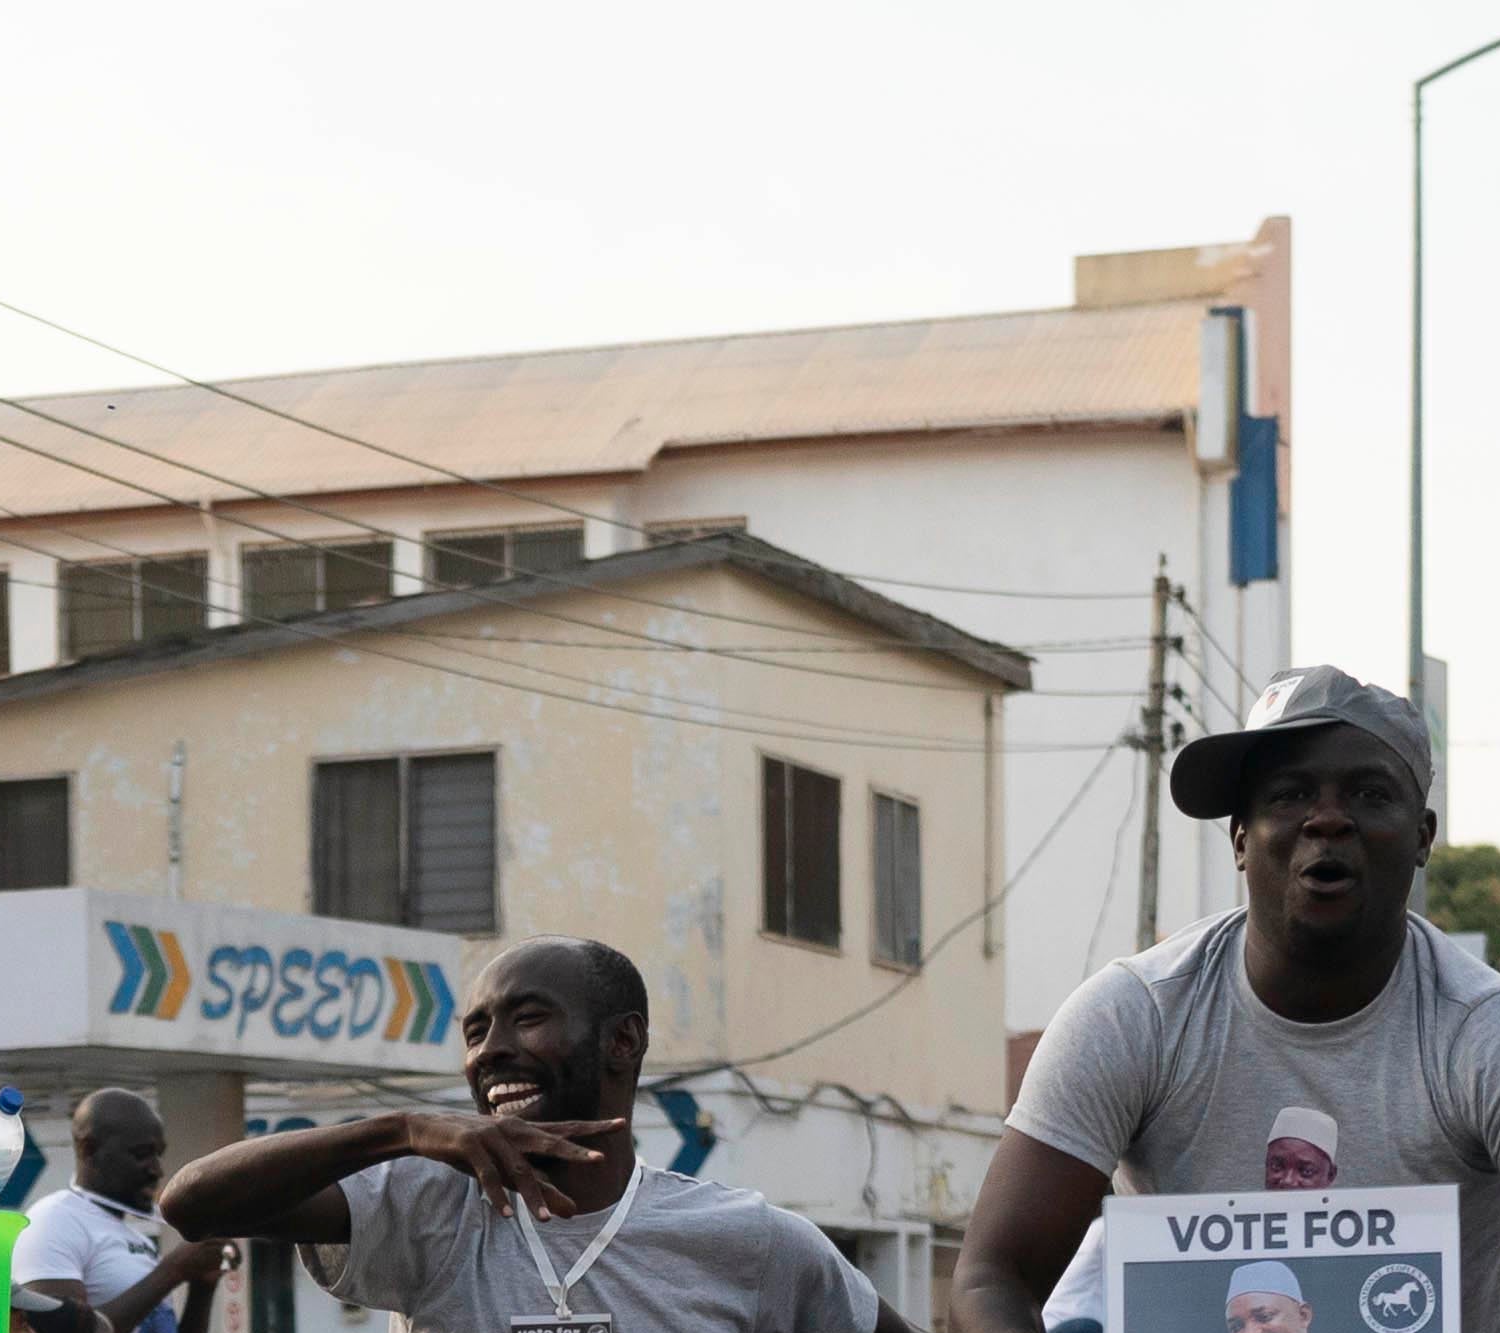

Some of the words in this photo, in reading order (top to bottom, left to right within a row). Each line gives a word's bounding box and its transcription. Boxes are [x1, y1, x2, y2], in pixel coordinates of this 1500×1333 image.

[201, 944, 386, 1041] SPEED
[1167, 1211, 1288, 1252] VOTE
[1304, 1208, 1396, 1250] FOR
